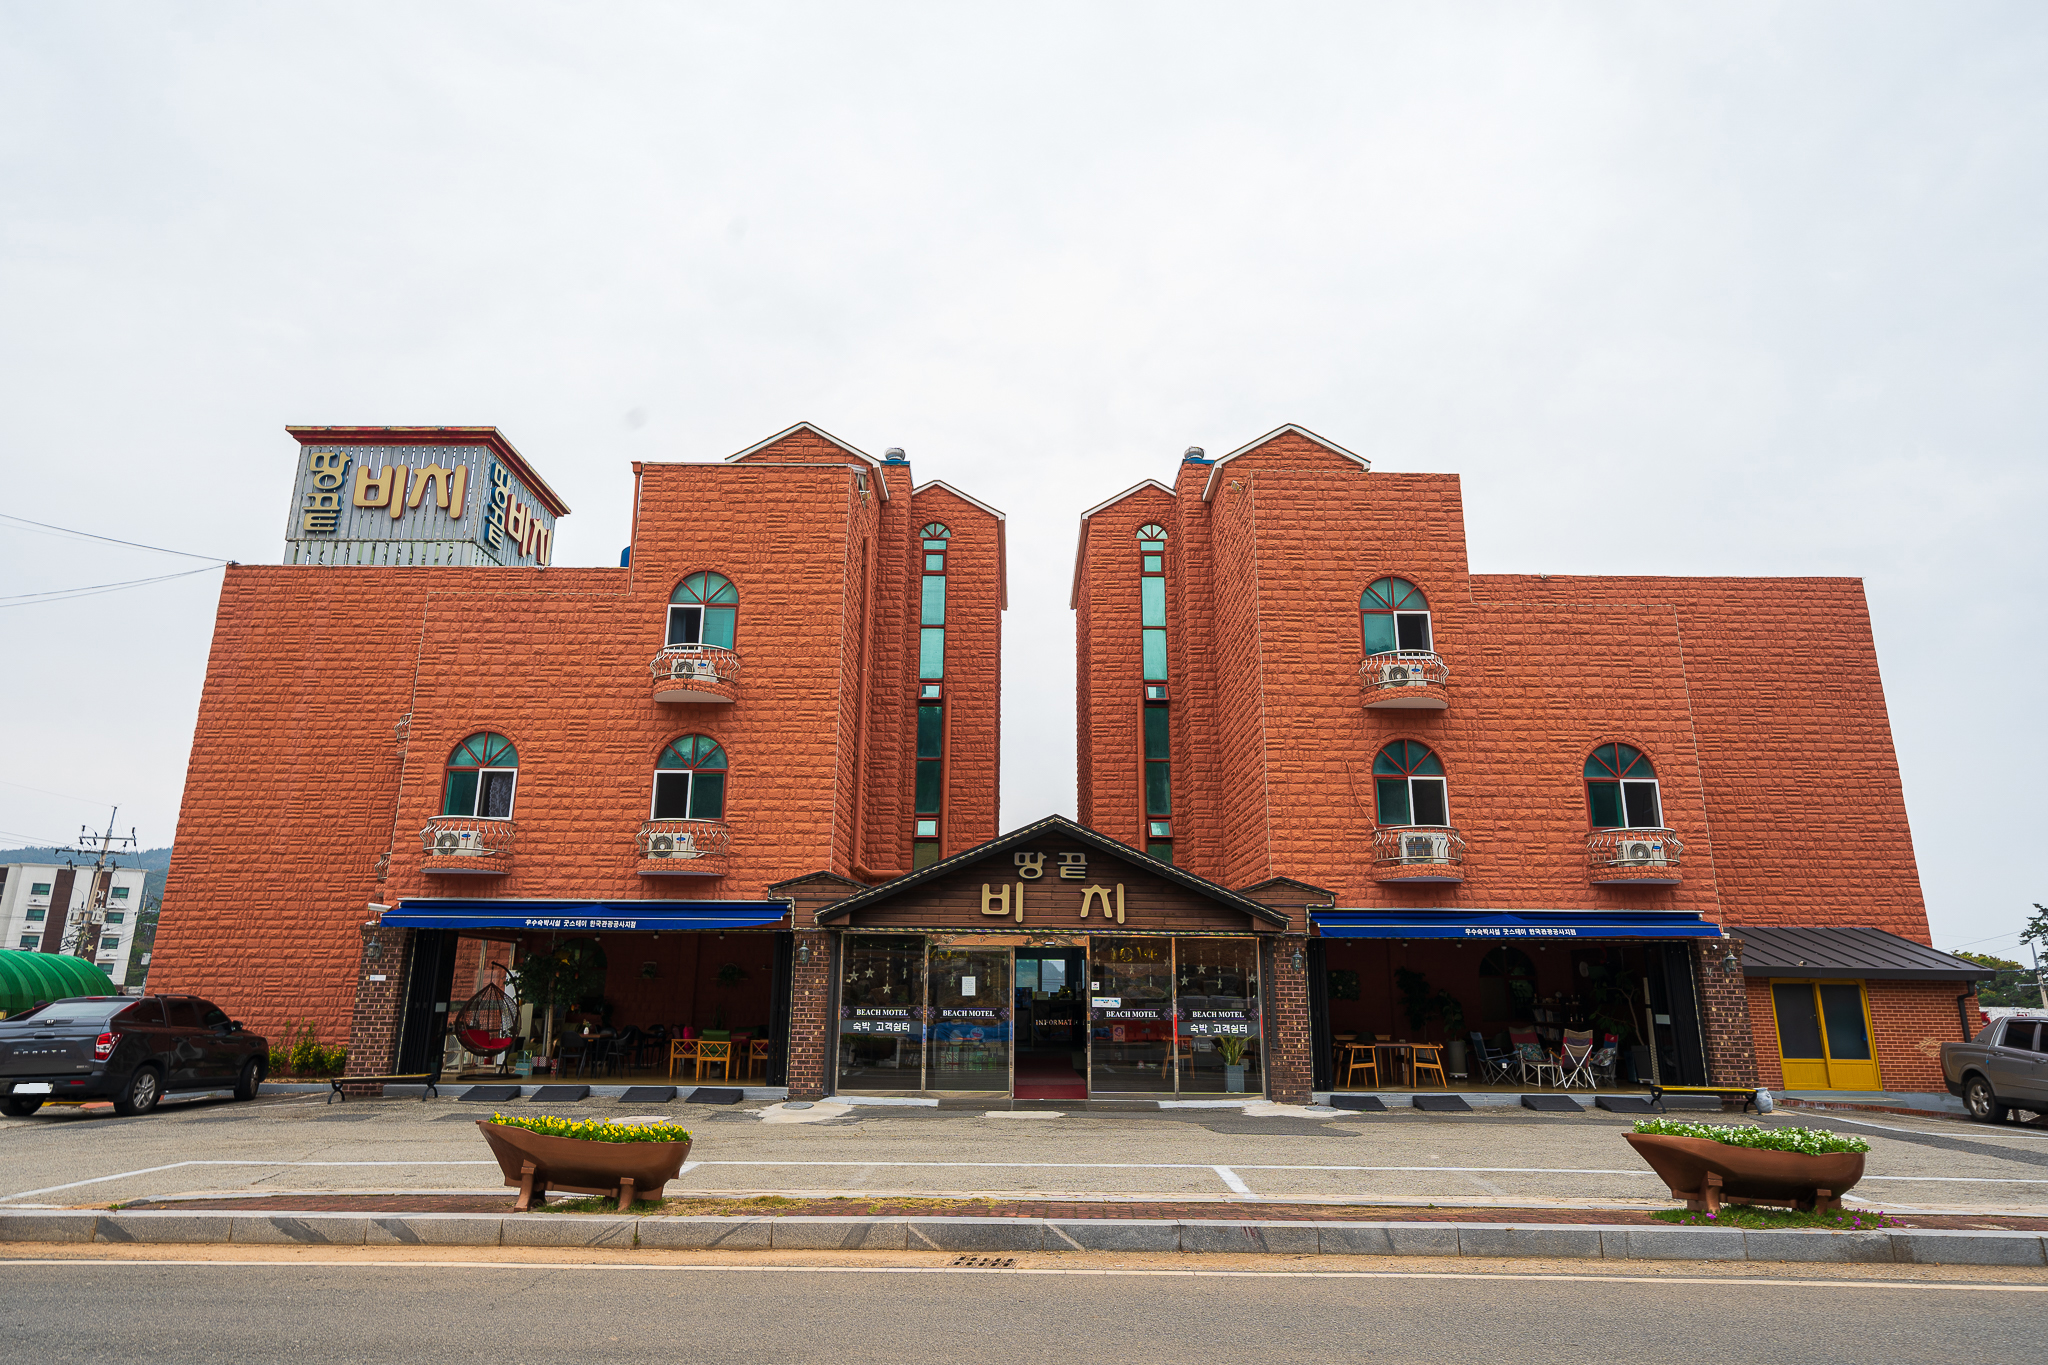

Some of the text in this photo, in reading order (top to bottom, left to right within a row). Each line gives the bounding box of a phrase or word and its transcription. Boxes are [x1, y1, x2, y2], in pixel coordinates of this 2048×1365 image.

[302, 451, 353, 532] 땅끝
[353, 463, 468, 520] 비치
[484, 463, 512, 550] 땅끝
[504, 494, 552, 566] 비치
[1014, 851, 1088, 879] 땅끝
[981, 881, 1125, 925] 비치
[852, 1021, 911, 1033] 숙박 고객쉼터
[856, 1008, 881, 1016] BEACH
[1105, 1010, 1131, 1018] BEACH
[1190, 1023, 1248, 1034] 숙박 고객쉼터
